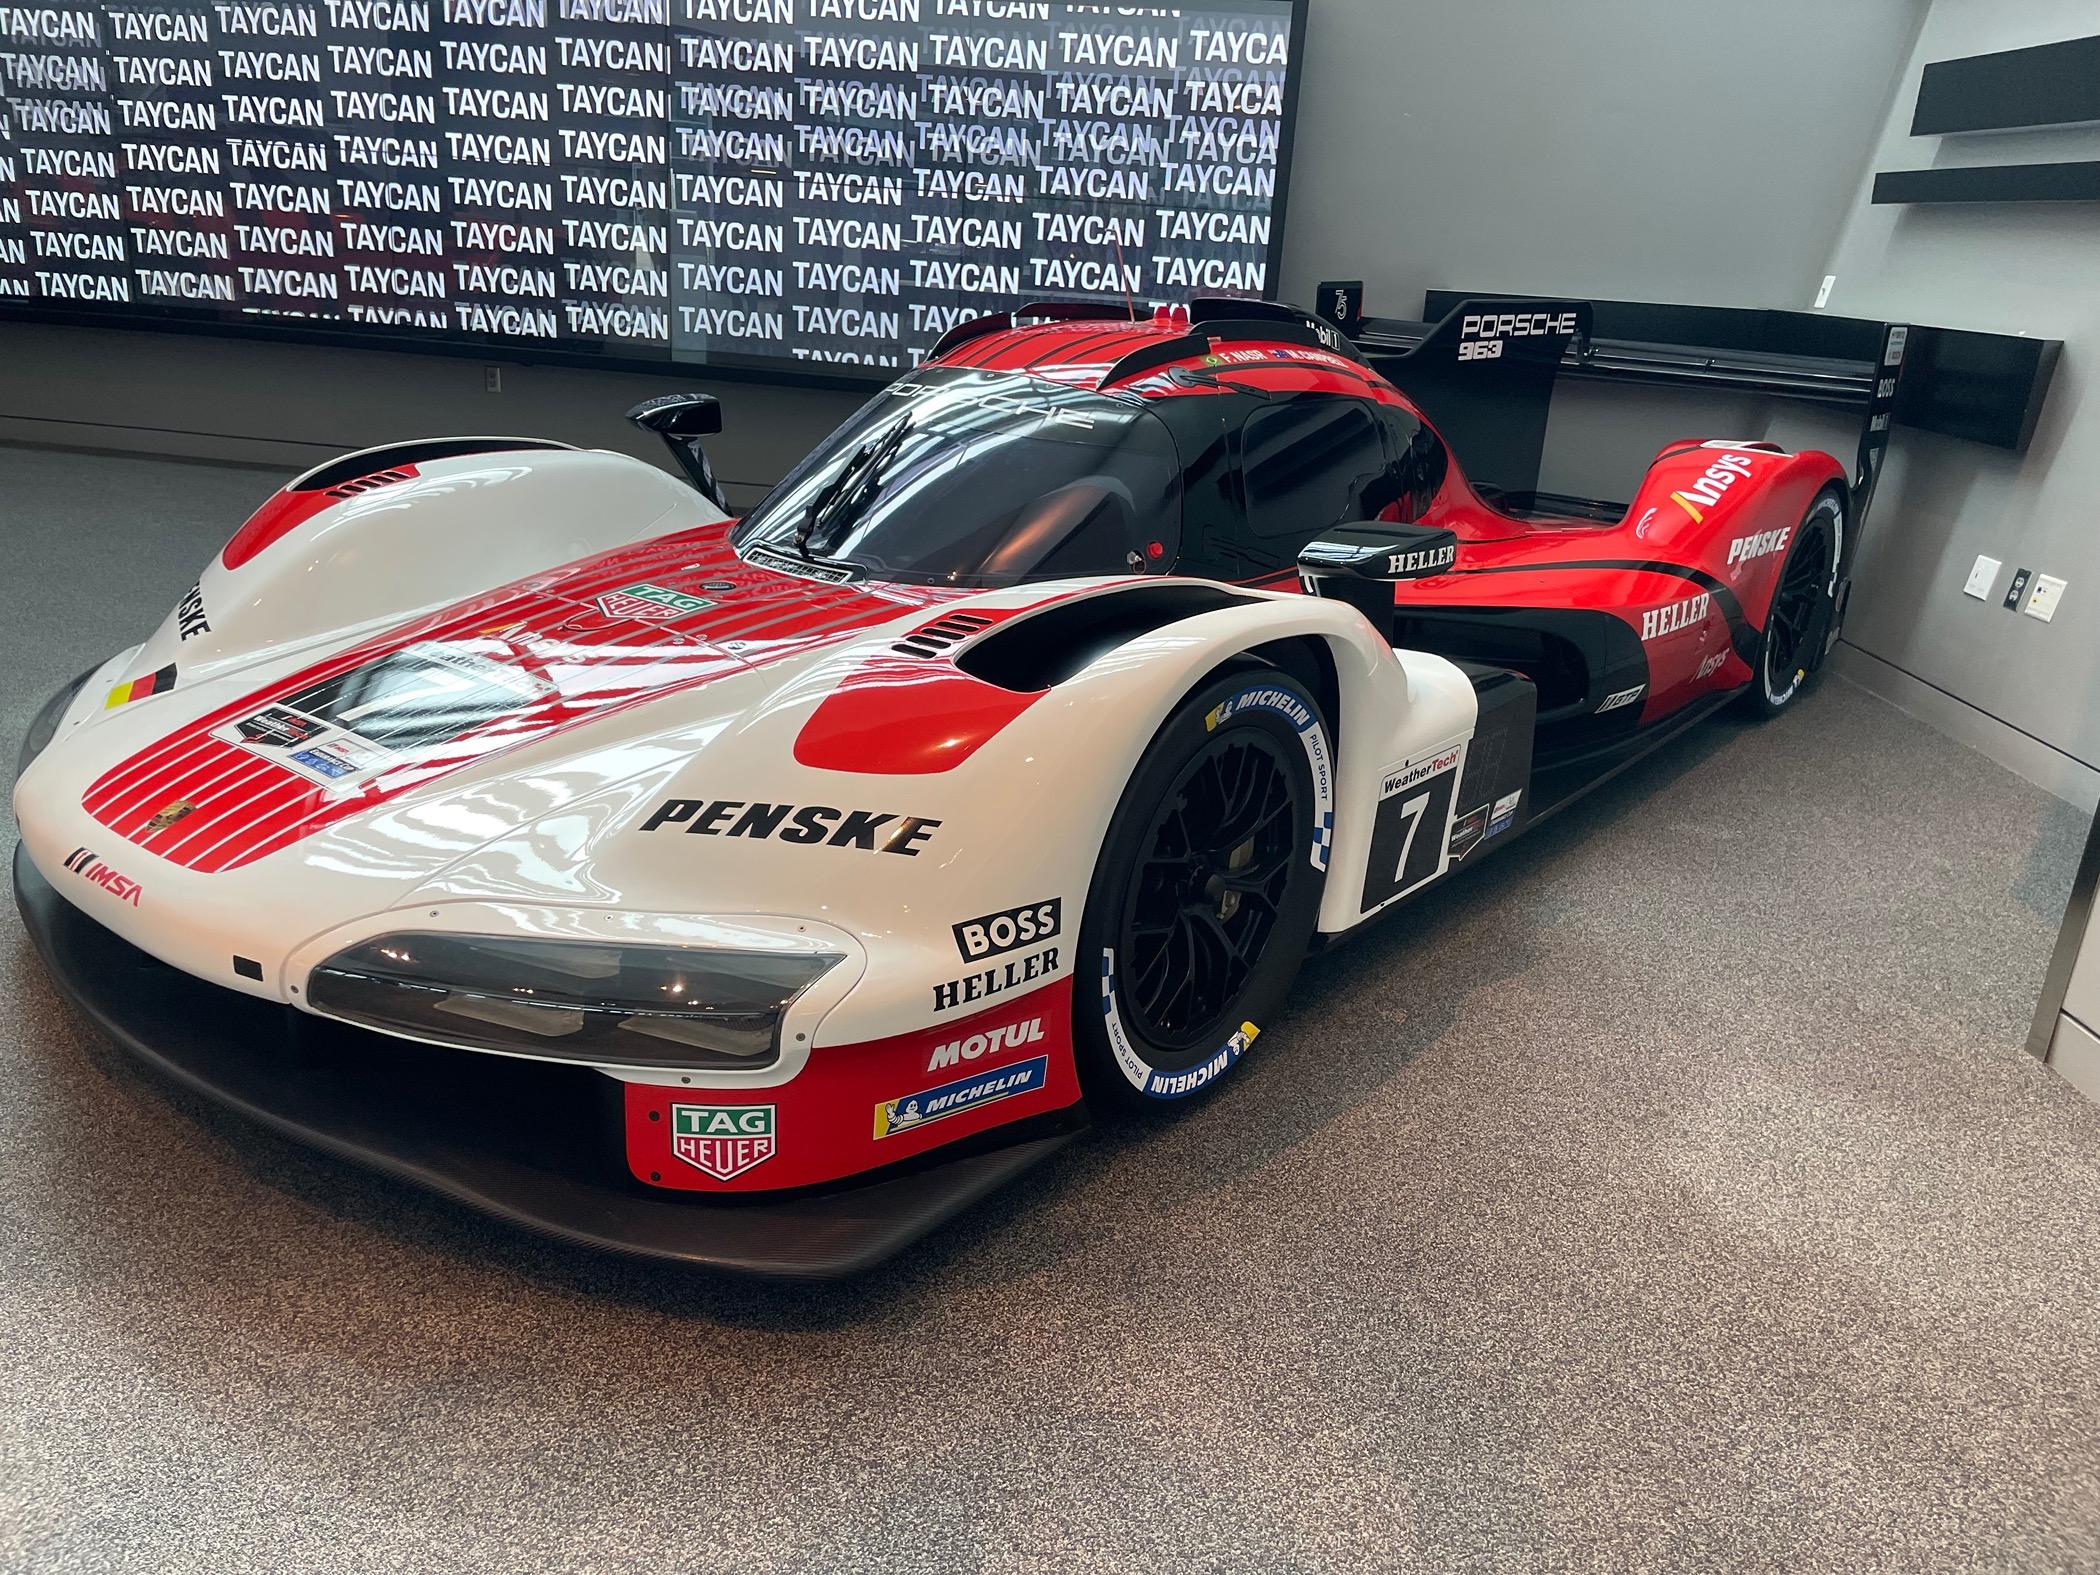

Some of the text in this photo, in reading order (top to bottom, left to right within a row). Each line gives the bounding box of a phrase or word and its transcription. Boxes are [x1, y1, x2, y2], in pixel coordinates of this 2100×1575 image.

[0, 8, 94, 39] TAYCAN
[109, 12, 207, 42] TAYCAN
[216, 6, 317, 36] TAYCAN
[324, 0, 429, 32] TAYCAN
[442, 0, 544, 27] TAYCAN
[218, 51, 320, 82] TAYCAN
[327, 46, 432, 78] TAYCAN
[440, 41, 546, 75] TAYCAN
[556, 37, 663, 73] TAYCAN
[681, 38, 793, 73] TAYCAN
[804, 37, 918, 72] TAYCAN
[929, 35, 1047, 70] TAYCAN
[1058, 32, 1178, 68] TAYCAN
[2, 52, 99, 83] TAYCAN
[112, 56, 212, 86] TAYCAN
[117, 99, 216, 130] TAYCAN
[222, 95, 323, 126] TAYCAN
[331, 91, 435, 124] TAYCAN
[442, 87, 549, 121] TAYCAN
[557, 84, 664, 118] TAYCAN
[681, 86, 793, 121] TAYCAN
[805, 86, 916, 120] TAYCAN
[928, 84, 1044, 119] TAYCAN
[1056, 83, 1173, 118] TAYCAN
[17, 105, 111, 134] TAYCAN
[122, 143, 219, 174] TAYCAN
[226, 139, 327, 171] TAYCAN
[334, 135, 438, 168] TAYCAN
[445, 132, 550, 166] TAYCAN
[559, 130, 665, 164] TAYCAN
[675, 128, 783, 162] TAYCAN
[21, 148, 114, 178] TAYCAN
[1160, 162, 1274, 197] TAYCAN
[229, 183, 330, 214] TAYCAN
[337, 180, 440, 213] TAYCAN
[448, 177, 552, 211] TAYCAN
[560, 175, 665, 208] TAYCAN
[676, 174, 782, 208] TAYCAN
[793, 171, 901, 206] TAYCAN
[913, 169, 1024, 203] TAYCAN
[1035, 166, 1148, 200] TAYCAN
[25, 190, 119, 220] TAYCAN
[126, 186, 223, 217] TAYCAN
[131, 228, 228, 259] TAYCAN
[234, 225, 333, 257] TAYCAN
[340, 223, 443, 256] TAYCAN
[451, 221, 554, 254] TAYCAN
[562, 220, 666, 253] TAYCAN
[677, 219, 782, 253] TAYCAN
[793, 217, 900, 250] TAYCAN
[911, 215, 1021, 249] TAYCAN
[1032, 213, 1144, 247] TAYCAN
[1155, 210, 1270, 244] TAYCAN
[30, 231, 124, 261] TAYCAN
[35, 272, 129, 301] TAYCAN
[135, 269, 232, 301] TAYCAN
[238, 267, 337, 299] TAYCAN
[344, 265, 445, 298] TAYCAN
[453, 264, 555, 297] TAYCAN
[564, 263, 667, 297] TAYCAN
[678, 263, 782, 296] TAYCAN
[793, 262, 899, 295] TAYCAN
[910, 261, 1019, 294] TAYCAN
[1030, 258, 1141, 293] TAYCAN
[1152, 256, 1265, 290] TAYCAN
[456, 306, 557, 339] TAYCAN
[566, 306, 668, 340] TAYCAN
[679, 306, 782, 339] TAYCAN
[793, 305, 897, 339] TAYCAN
[1461, 312, 1577, 338] PORSCHE
[1457, 340, 1504, 361] 963
[1877, 379, 1896, 398] BOSS
[1670, 452, 1753, 525] Ansys
[1388, 545, 1455, 574] HELLER
[1727, 525, 1791, 566] PENSKE
[604, 593, 681, 618] HEUER
[636, 586, 700, 609] TAG
[1641, 592, 1710, 641] HELLER
[1236, 690, 1310, 727] MICHELIN
[1309, 734, 1328, 801] PILOT SPORT
[1385, 752, 1457, 793] WeatherTech
[639, 798, 943, 857] PENSKE
[1394, 792, 1430, 883] 7
[85, 863, 143, 907] IMSA
[963, 905, 1055, 956] BOSS
[932, 947, 1059, 1012] HELLER
[927, 1017, 1045, 1072] MOTUL
[1111, 1021, 1143, 1080] PILOT SPORT
[1151, 1049, 1229, 1095] MICHELIN
[925, 1069, 1033, 1113] MICHELIN
[678, 1110, 766, 1133] TAG
[678, 1137, 769, 1175] HEUER
